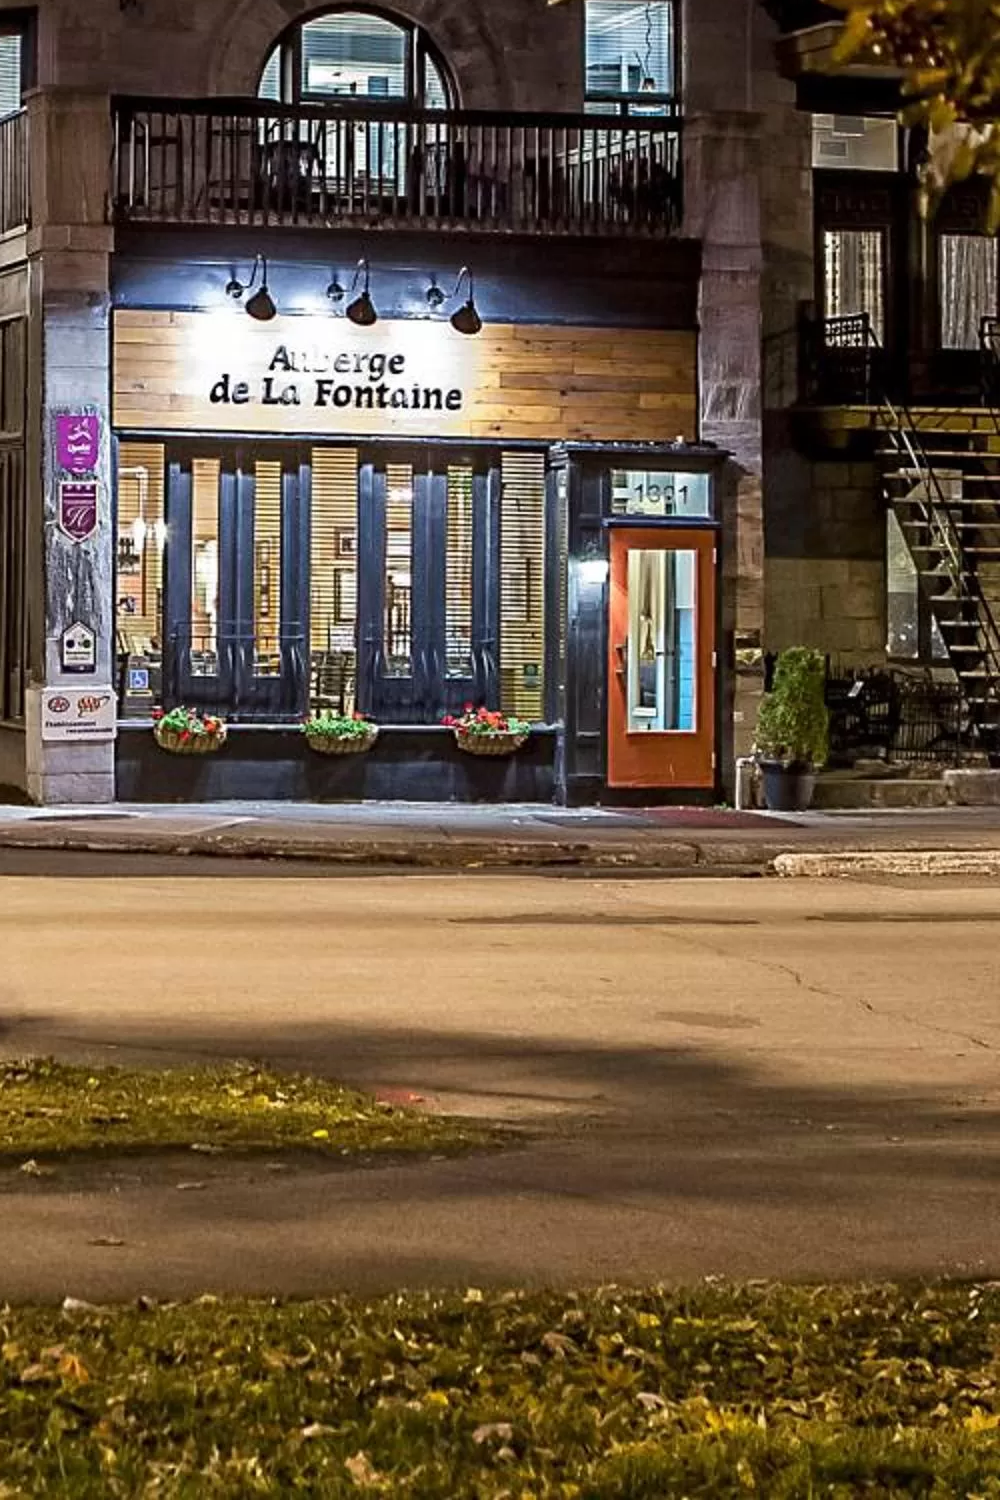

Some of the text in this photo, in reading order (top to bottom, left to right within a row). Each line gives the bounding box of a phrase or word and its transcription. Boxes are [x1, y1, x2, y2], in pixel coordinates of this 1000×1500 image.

[209, 373, 463, 410] de La Fontaine
